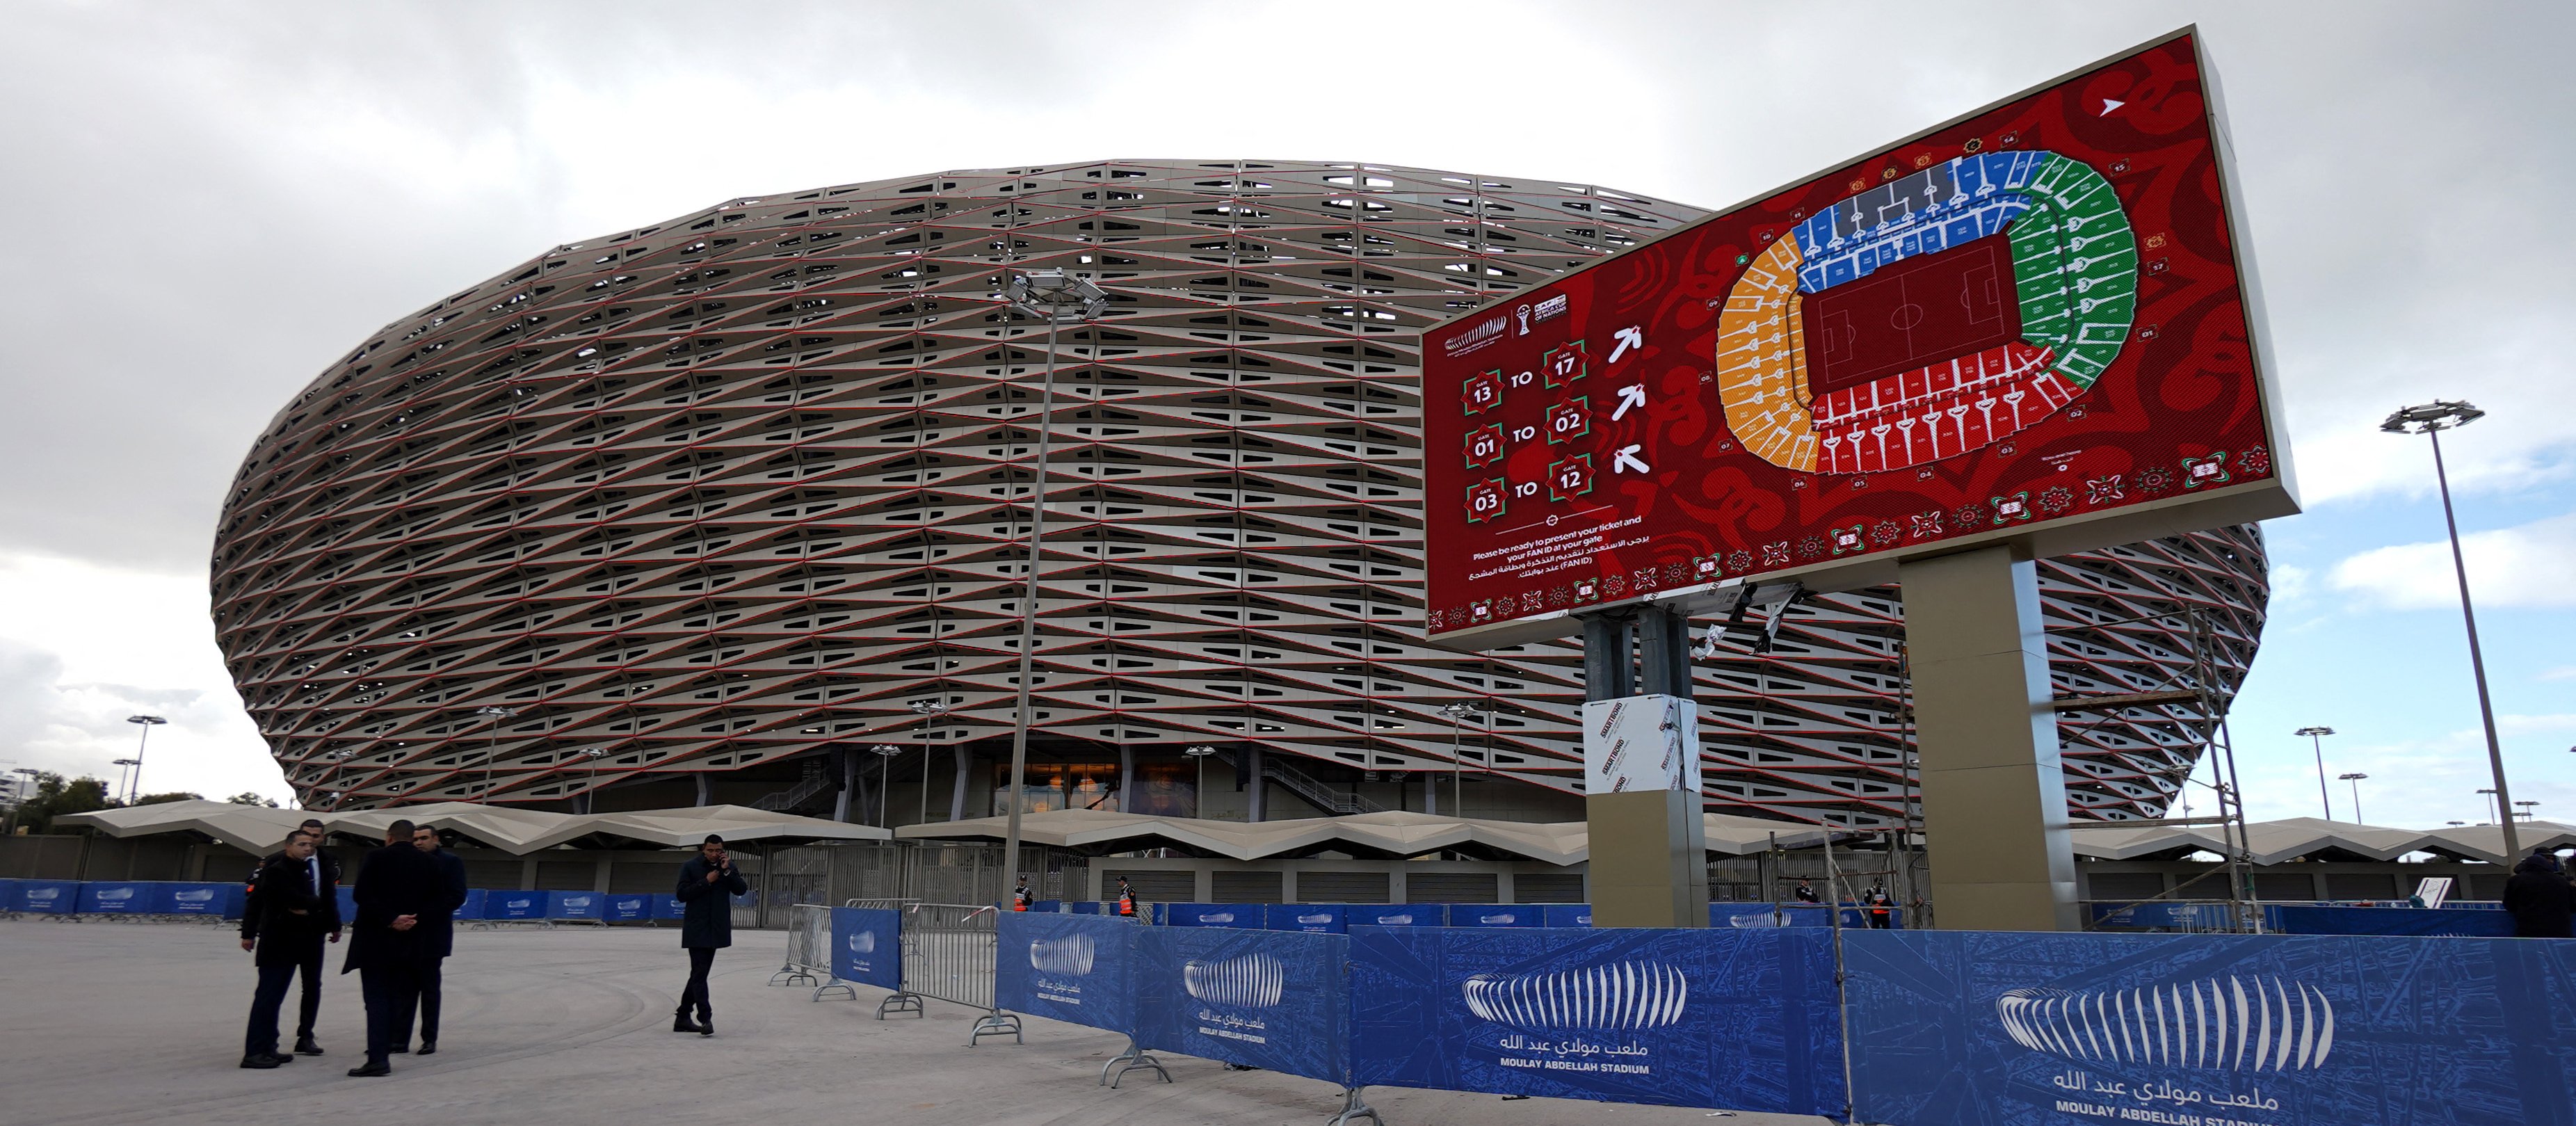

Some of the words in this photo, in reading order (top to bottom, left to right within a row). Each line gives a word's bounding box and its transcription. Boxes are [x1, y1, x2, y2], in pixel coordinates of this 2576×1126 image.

[1474, 387, 1492, 403] 13
[1511, 371, 1533, 388] TO
[1555, 357, 1575, 376] 17
[1561, 408, 1574, 416] GATE
[1474, 440, 1494, 457] 01
[1513, 426, 1536, 442] TO
[1555, 413, 1581, 433] 02
[1475, 494, 1497, 511] 03
[1515, 482, 1538, 498] TO
[1561, 472, 1581, 489] 12
[1473, 550, 1498, 561] Please
[1511, 541, 1534, 552] ready
[1545, 531, 1577, 545] present
[1577, 527, 1598, 538] your
[1600, 520, 1623, 531] ticket
[1623, 515, 1642, 526] and
[1627, 536, 1650, 546] يرجى
[1507, 553, 1526, 563] your
[1527, 548, 1543, 557] FAN
[1562, 540, 1582, 550] your
[1583, 536, 1603, 547] gate
[1586, 540, 1625, 554] الاستعداد
[1527, 556, 1554, 568] التذكرة
[1556, 549, 1584, 562] لتقديم
[1498, 563, 1526, 572] وبطاقة
[1561, 559, 1580, 570] (FAN
[1469, 568, 1497, 580] المشجع
[1600, 701, 1623, 739] SMARTBOND
[1602, 739, 1625, 775] SMARTBOND
[1038, 978, 1046, 988] الله
[1053, 981, 1067, 994] مولاي
[1068, 983, 1081, 994] ملعب
[1199, 1008, 1210, 1020] الله
[1211, 1014, 1222, 1024] عبد
[1223, 1013, 1243, 1028] مولاي
[1244, 1017, 1265, 1029] ملعب
[1199, 1027, 1218, 1036] MOULAY
[1218, 1030, 1242, 1040] ABDELLAH
[1243, 1033, 1266, 1044] STADIUM
[1499, 1034, 1523, 1049] الله
[1529, 1040, 1550, 1054] عبد
[1555, 1038, 1600, 1058] مولاي
[1604, 1040, 1648, 1058] ملعب
[1501, 1057, 1543, 1068] MOULAY
[1545, 1061, 1598, 1072] ABDELLAH
[1601, 1063, 1649, 1074] STADIUM
[2054, 1070, 2086, 1091] الله
[2094, 1081, 2127, 1098] عبد
[2134, 1079, 2201, 1107] مولاي
[2209, 1088, 2279, 1111] ملعب
[2056, 1100, 2116, 1118] MOULAY
[2120, 1108, 2200, 1126] ABDELLAH
